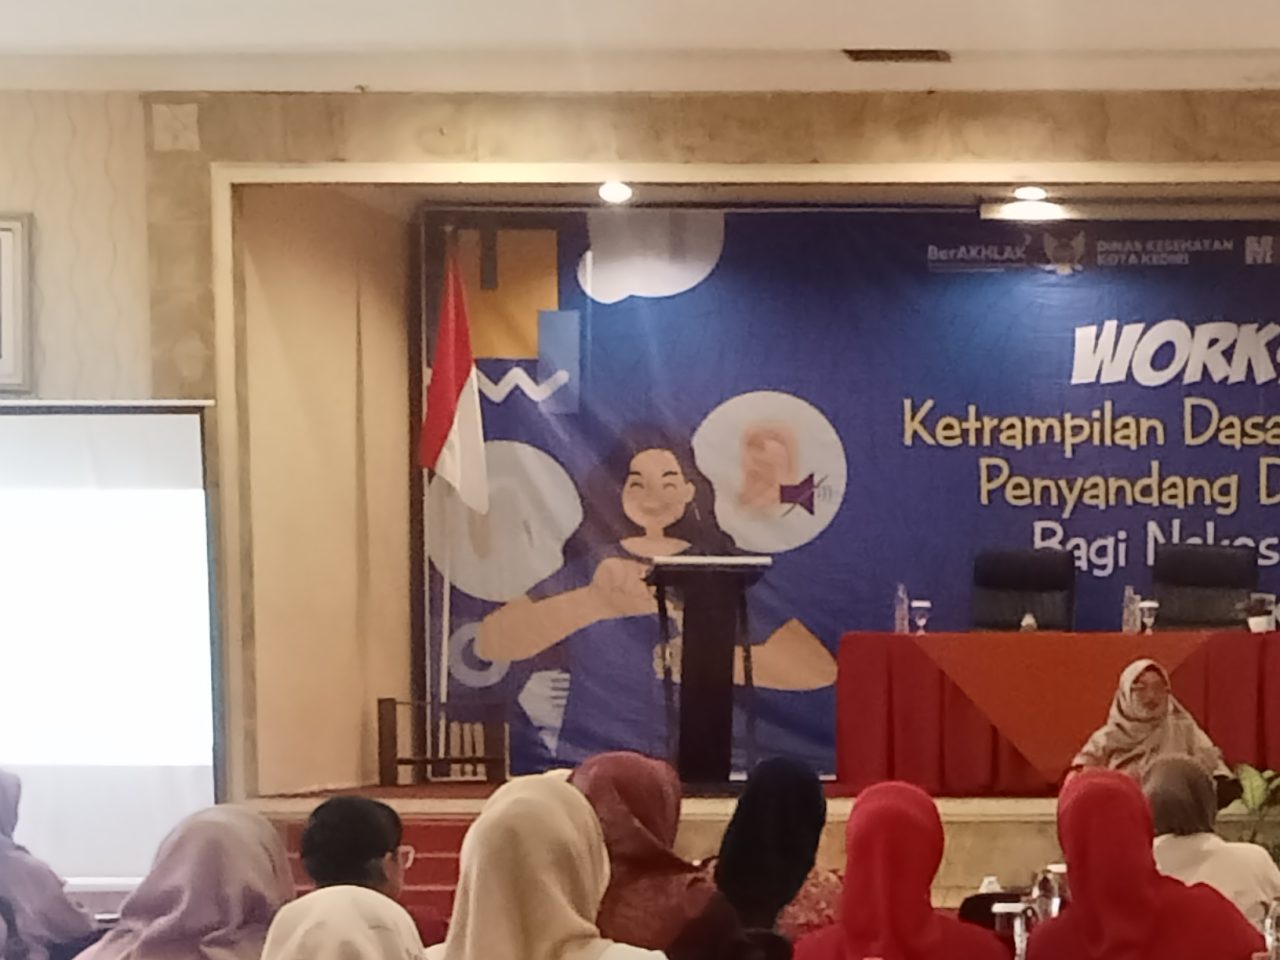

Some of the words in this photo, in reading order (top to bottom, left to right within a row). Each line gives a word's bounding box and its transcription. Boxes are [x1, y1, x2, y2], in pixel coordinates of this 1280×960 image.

[903, 398, 1165, 458] Ketrampilan
[979, 456, 1239, 519] Penyandang
[1033, 520, 1127, 577] Bagi
